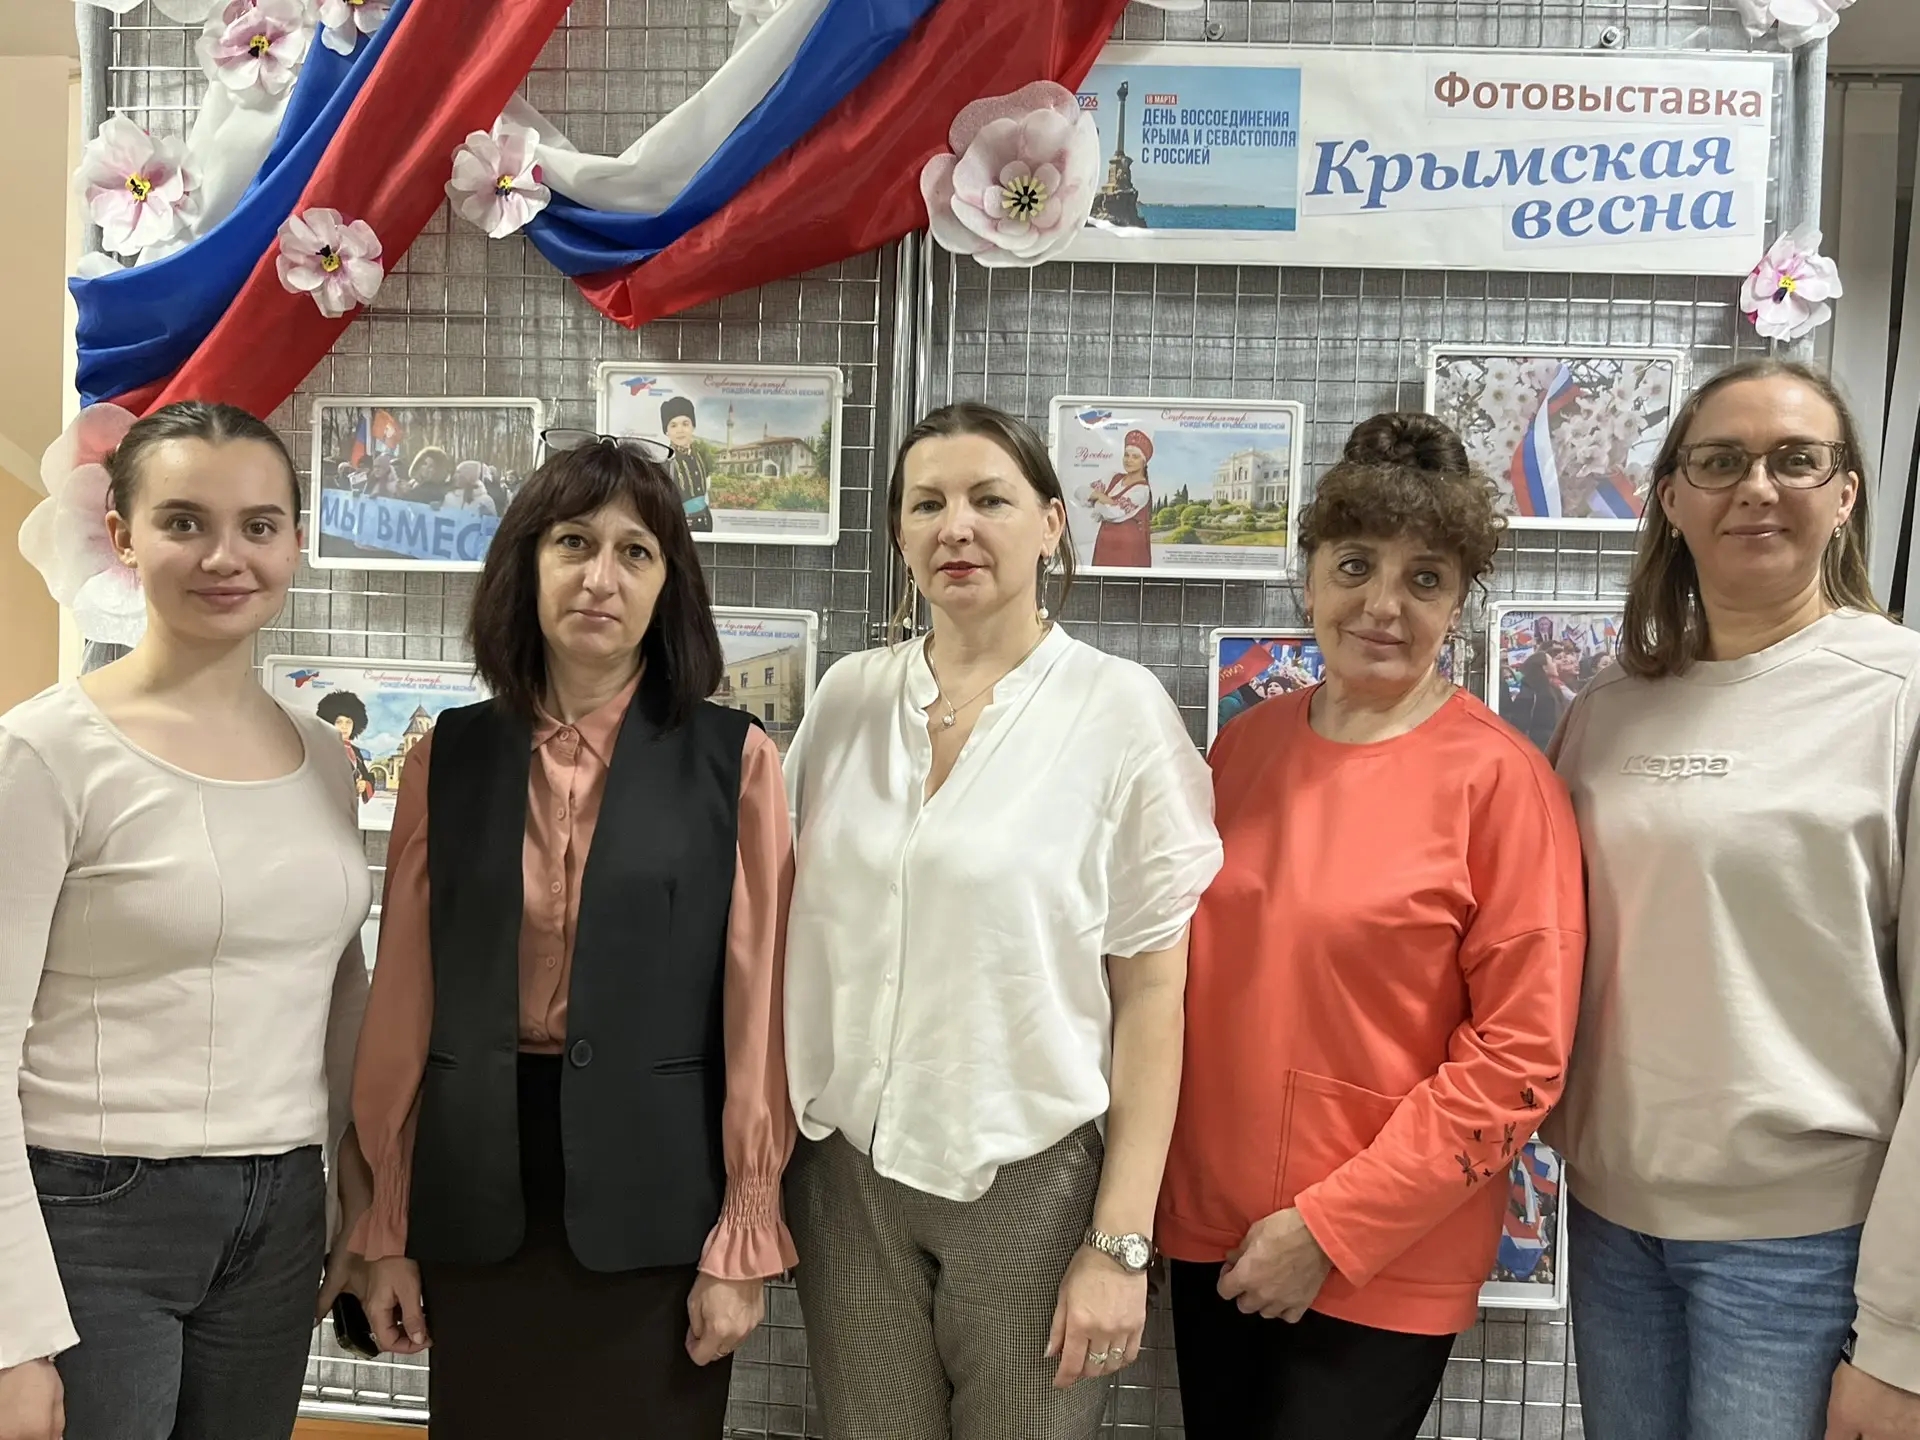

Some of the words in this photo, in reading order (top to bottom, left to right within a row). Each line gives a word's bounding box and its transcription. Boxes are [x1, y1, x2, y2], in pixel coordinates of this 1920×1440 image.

[1075, 95, 1098, 107] 026
[1154, 95, 1176, 105] МАРТА
[1434, 71, 1762, 119] Фотовыставка
[1143, 108, 1176, 126] ДЕНЬ
[1181, 109, 1289, 127] ВОССОЕДИНЕНИЯ
[1142, 128, 1190, 145] КРЫМА
[1194, 129, 1202, 145] И
[1206, 129, 1296, 147] СЕВАСТОПОЛЯ
[1142, 148, 1149, 163] С
[1153, 146, 1210, 164] РОССИЕЙ
[1305, 136, 1736, 209] Крымская
[1511, 188, 1736, 240] весна
[322, 495, 366, 536] МЫ
[1620, 754, 1729, 779] Kappa
